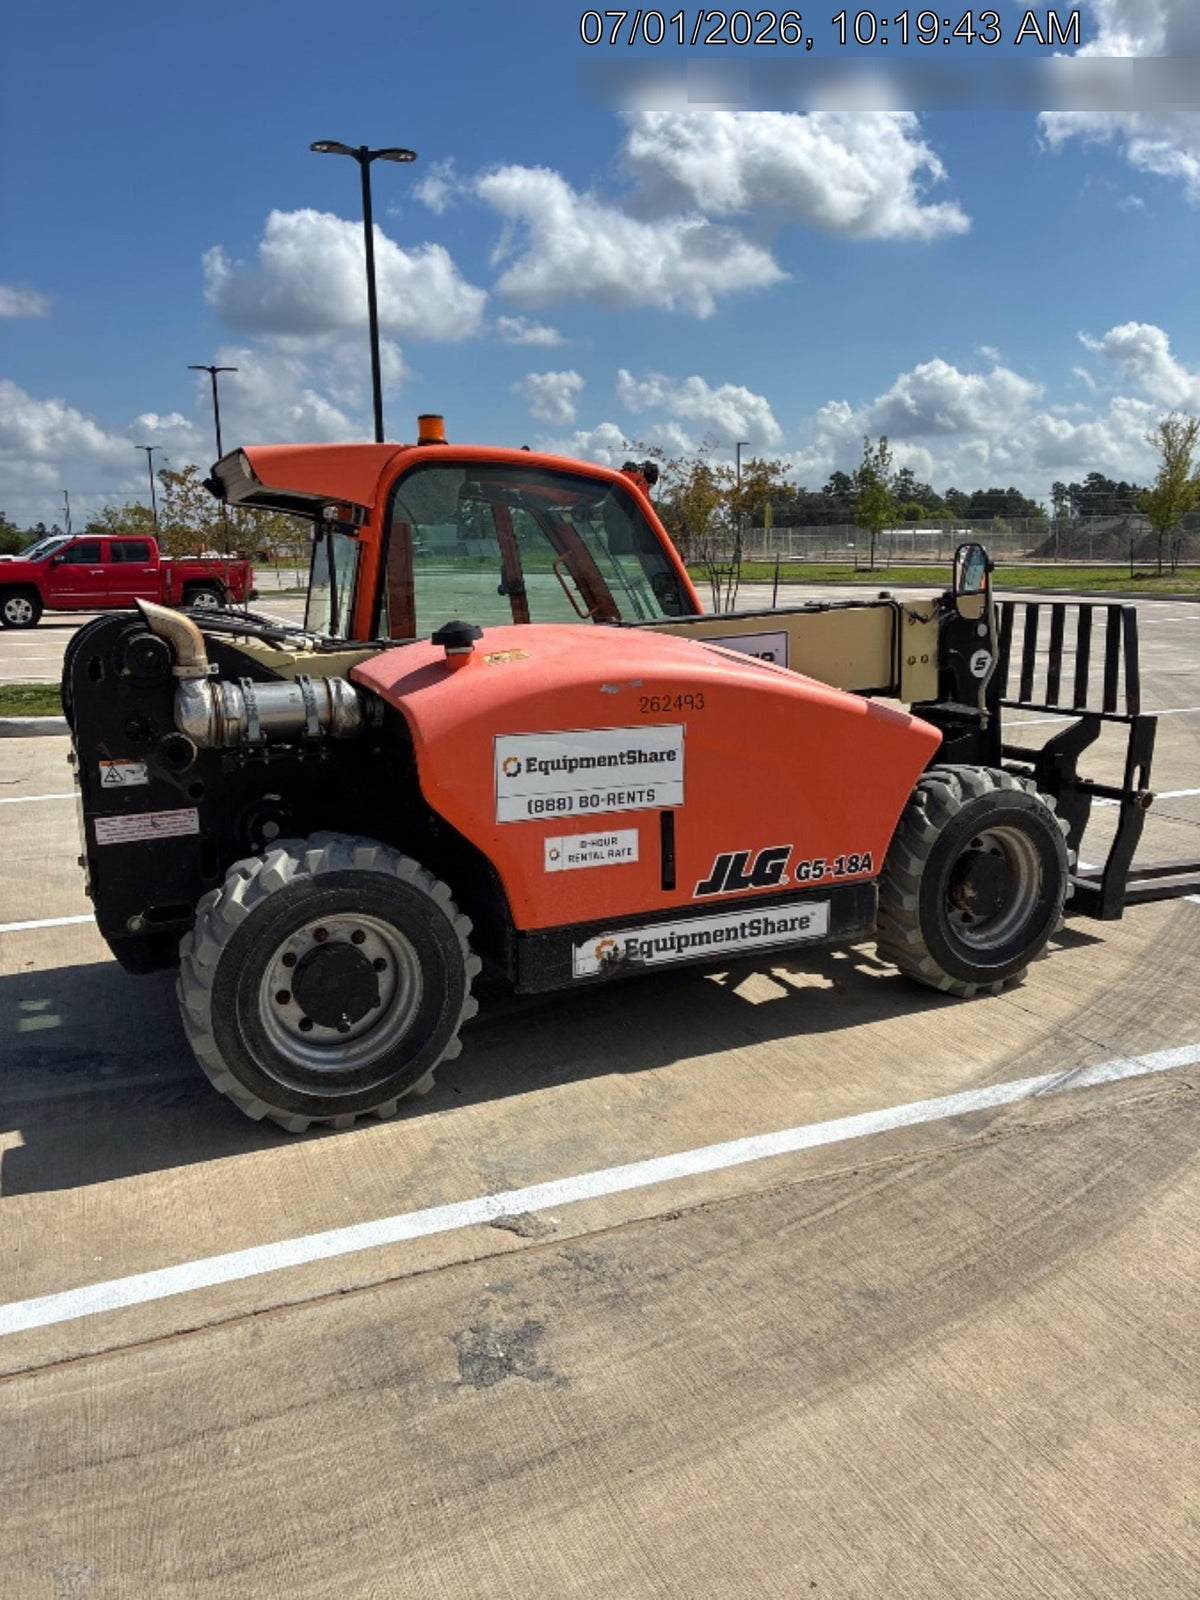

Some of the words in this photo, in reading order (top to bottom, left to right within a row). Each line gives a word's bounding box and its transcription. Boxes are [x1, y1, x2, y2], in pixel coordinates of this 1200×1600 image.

[639, 693, 705, 714] 262493
[525, 750, 677, 775] EquipmentShare
[527, 796, 574, 815] (888)
[568, 851, 605, 863] RENTAL
[607, 847, 632, 859] RATE
[693, 844, 793, 898] JLG
[795, 852, 872, 882] G5-18A
[624, 914, 811, 959] EquipmentShare
